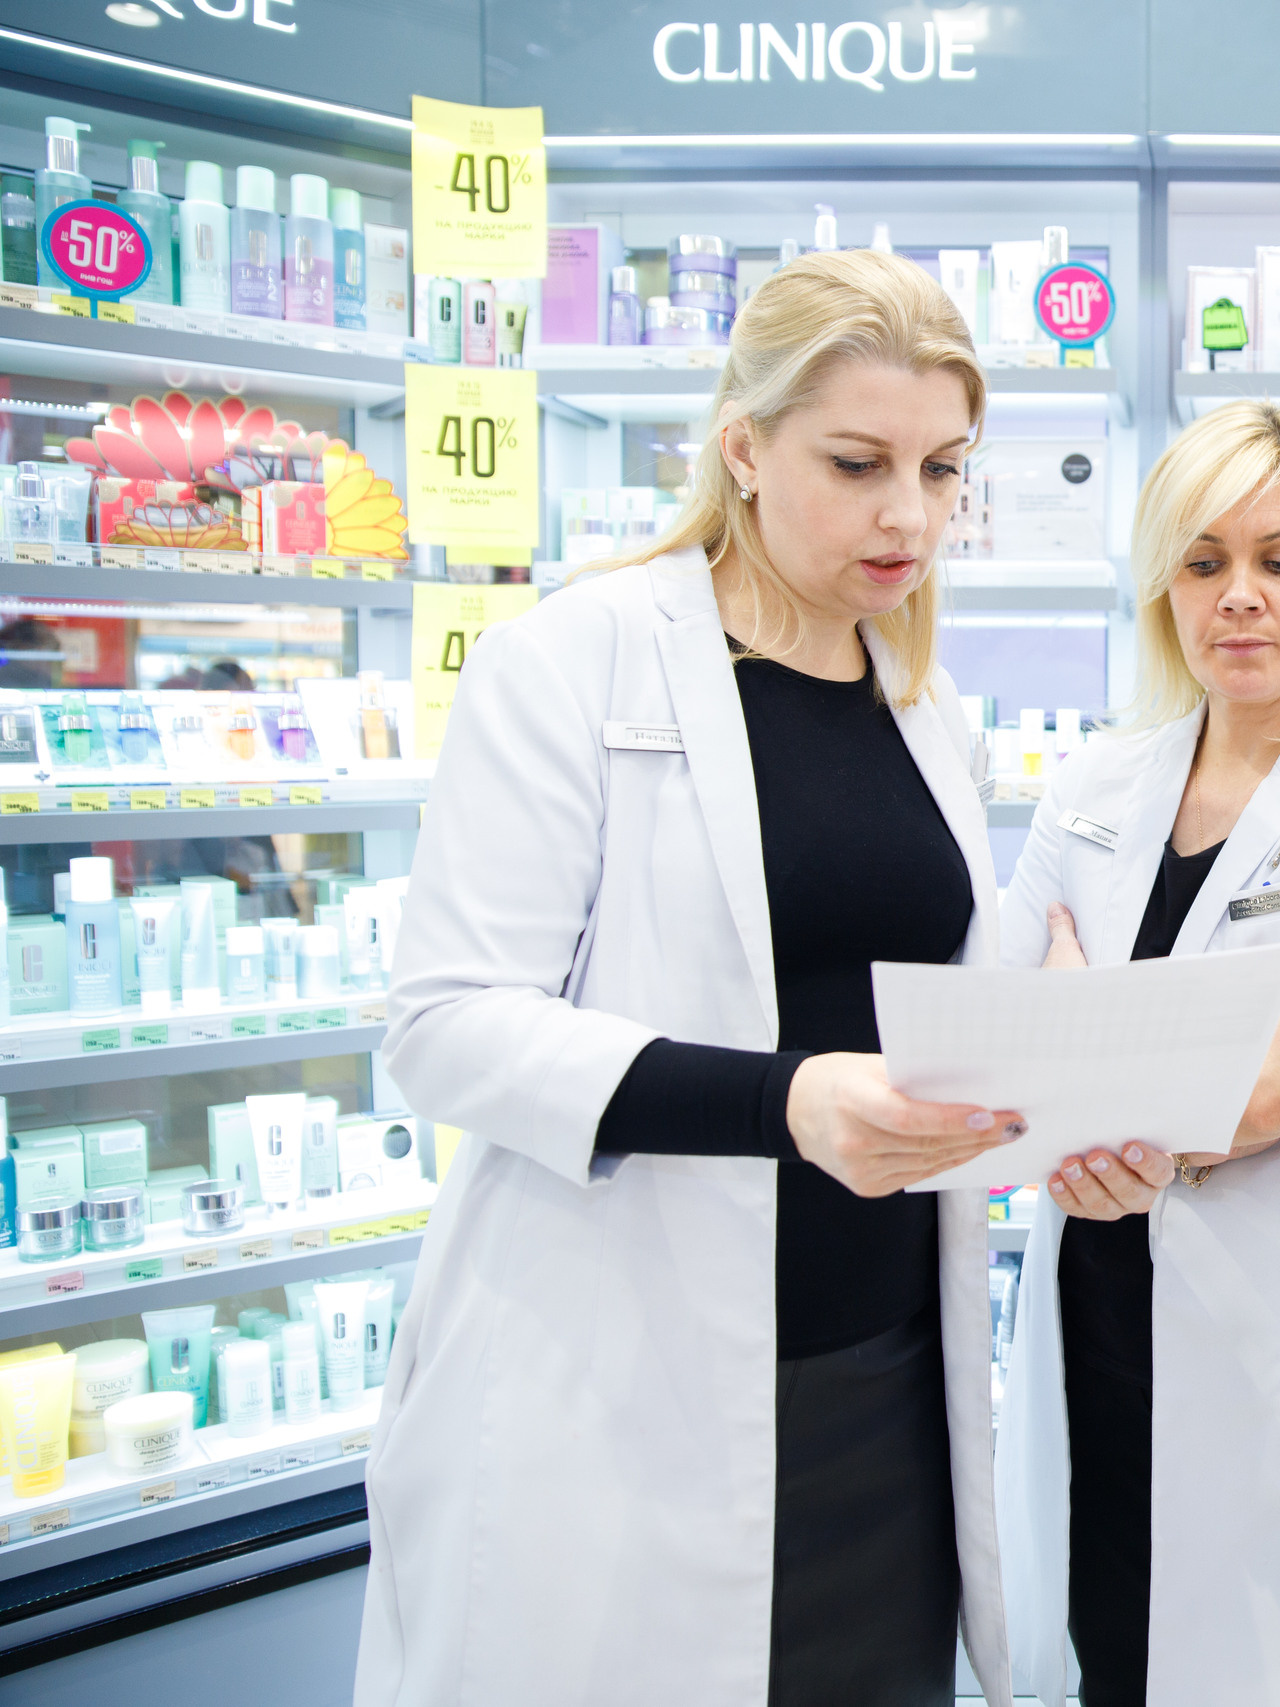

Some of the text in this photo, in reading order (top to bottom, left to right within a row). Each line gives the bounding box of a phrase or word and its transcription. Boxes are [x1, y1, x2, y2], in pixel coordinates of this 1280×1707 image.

[653, 21, 979, 91] CLINIQUE
[67, 218, 136, 274] 50%
[1050, 281, 1102, 325] 50%
[86, 1376, 135, 1393] CLINIQUE
[13, 1375, 38, 1469] CLINIQUE
[133, 1429, 181, 1449] CLINIQUE
